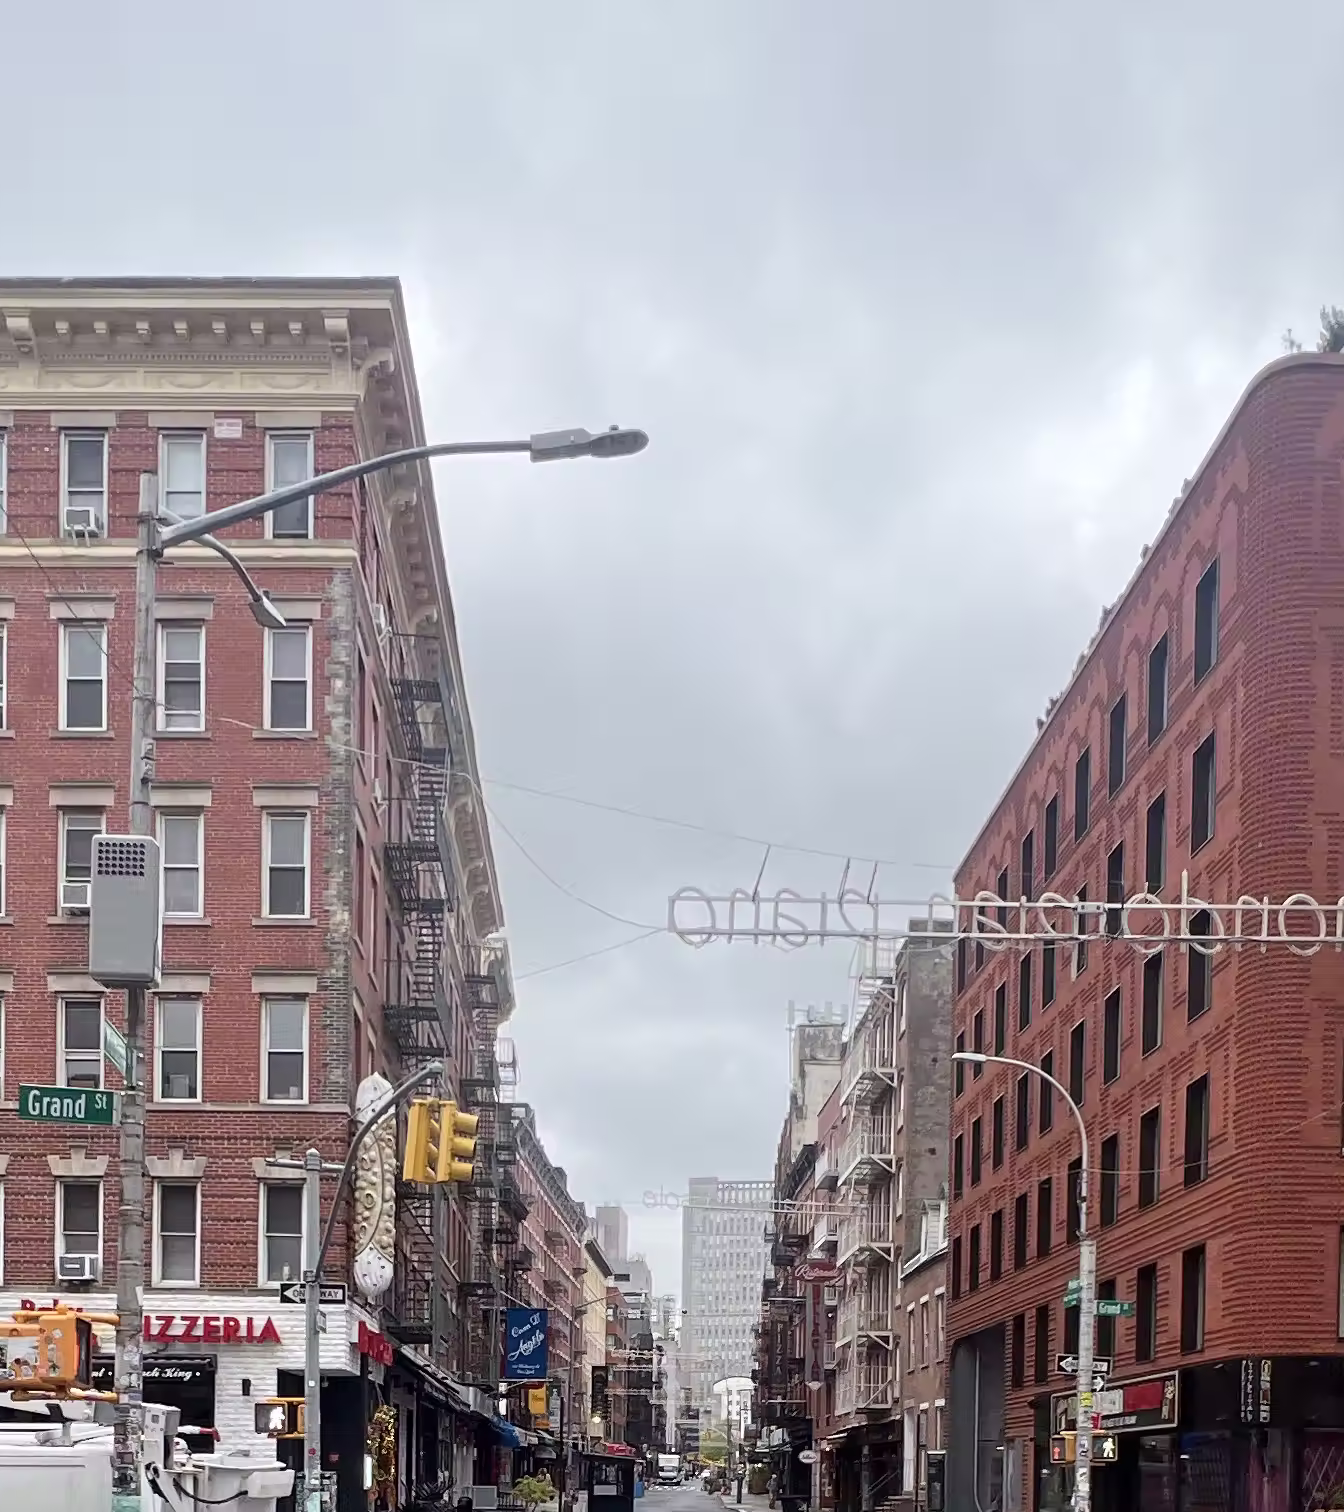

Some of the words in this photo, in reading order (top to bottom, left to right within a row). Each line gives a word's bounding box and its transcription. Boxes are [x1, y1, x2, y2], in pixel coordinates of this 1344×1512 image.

[28, 1089, 86, 1118] Grand
[94, 1093, 107, 1109] St
[142, 1315, 282, 1344] IZZERIA
[161, 1366, 194, 1381] King
